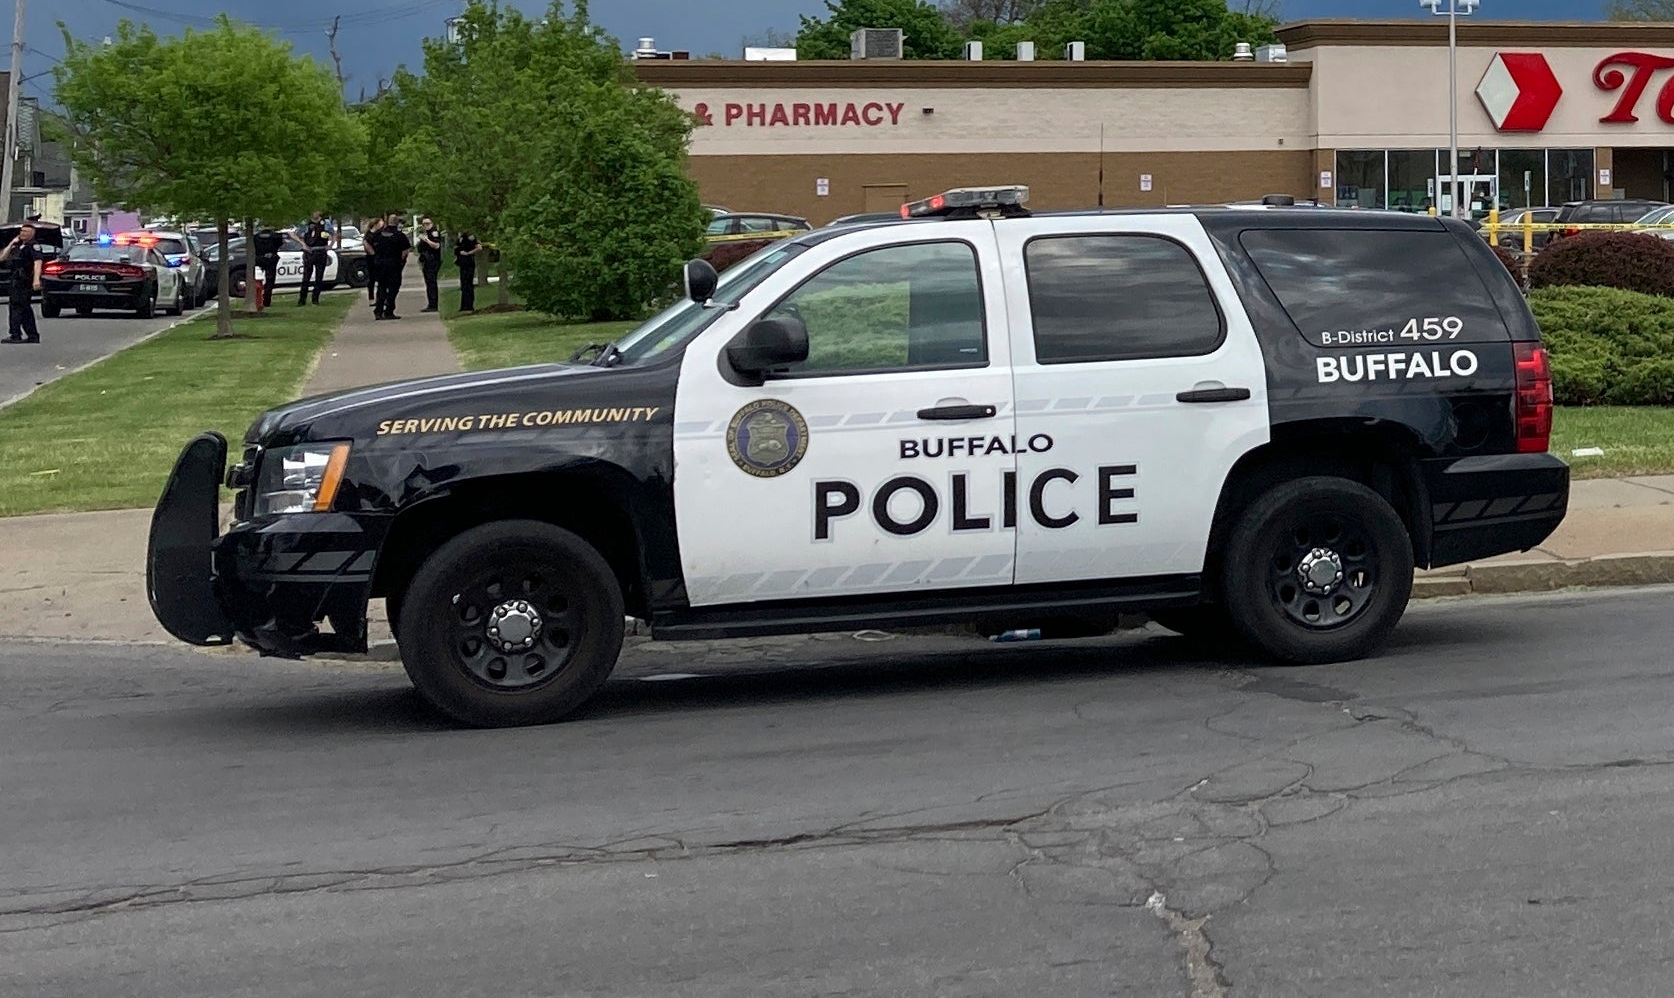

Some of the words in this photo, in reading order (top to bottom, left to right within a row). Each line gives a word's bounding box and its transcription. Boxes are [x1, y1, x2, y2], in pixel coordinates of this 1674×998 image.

[694, 102, 714, 126] &
[725, 102, 905, 126] PHARMACY
[1321, 329, 1394, 344] B-District
[1400, 316, 1463, 340] 459
[1316, 349, 1478, 383] BUFFALO
[376, 416, 473, 436] SERVING
[478, 412, 520, 429] THE
[522, 407, 659, 427] COMMUNITY
[900, 433, 1053, 459] BUFFALO
[814, 464, 1138, 540] POLICE
